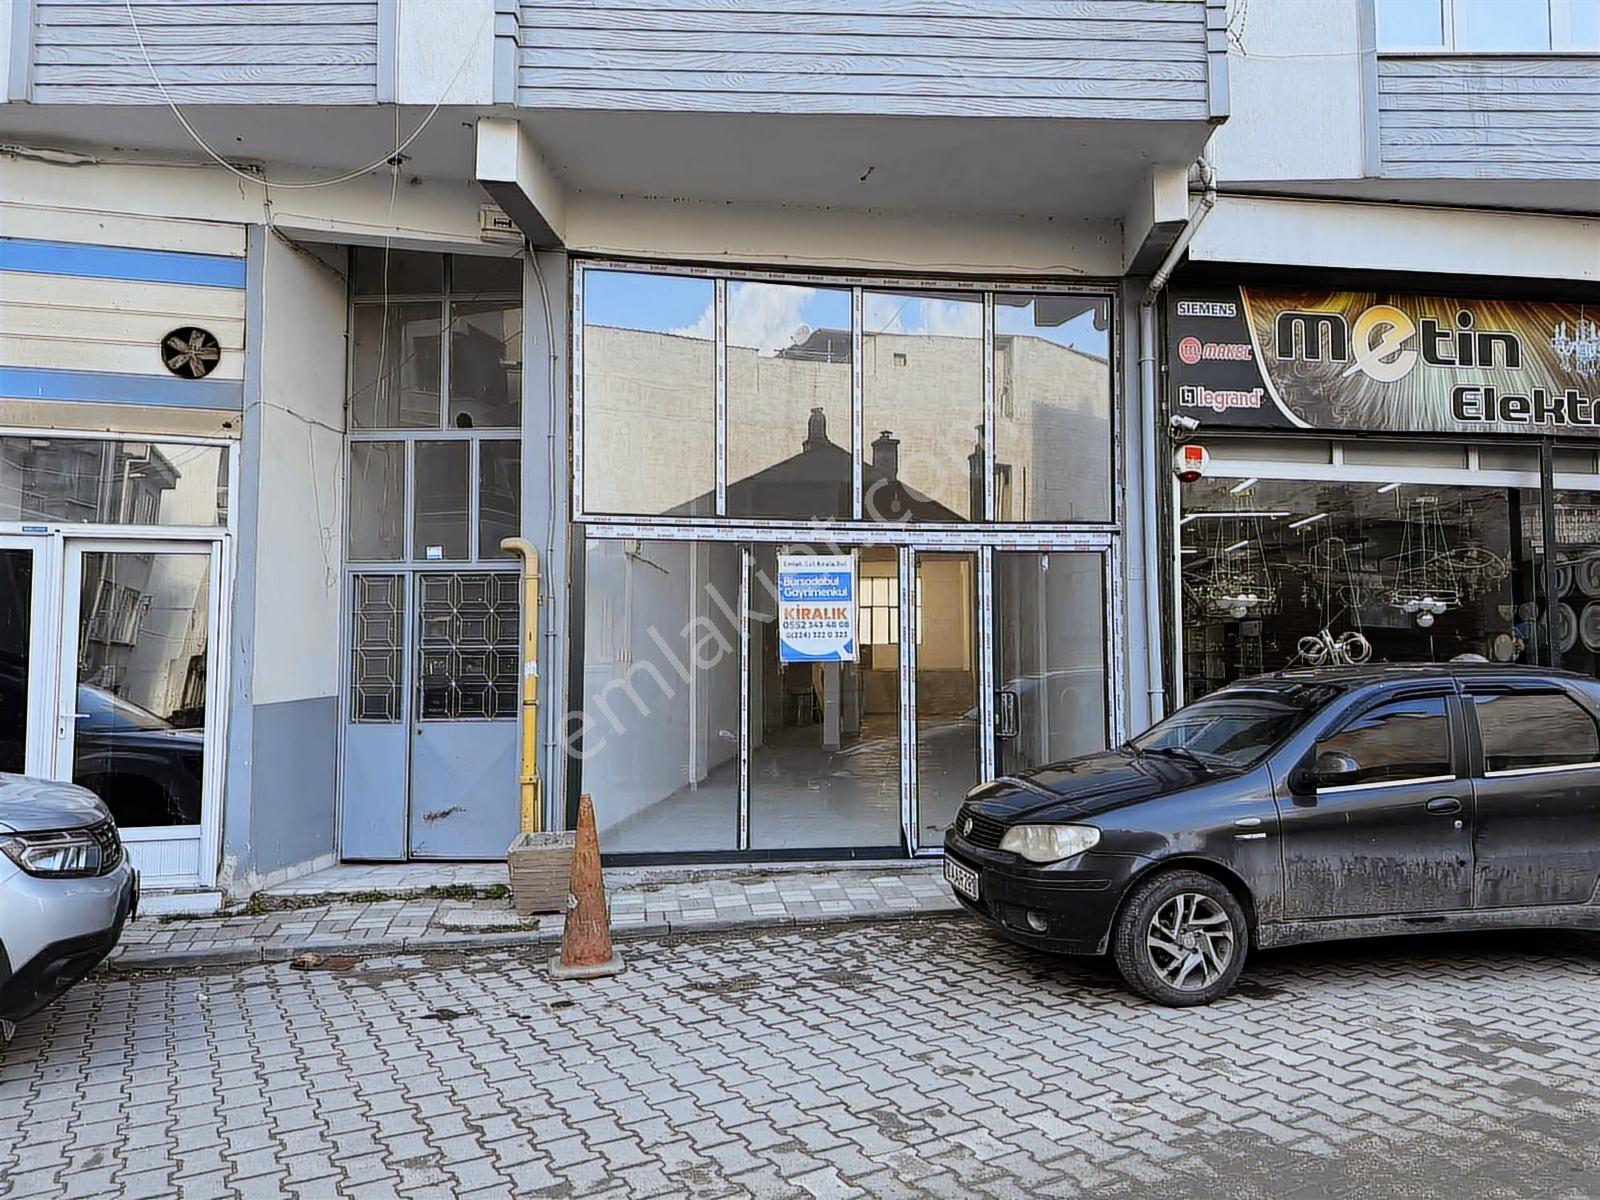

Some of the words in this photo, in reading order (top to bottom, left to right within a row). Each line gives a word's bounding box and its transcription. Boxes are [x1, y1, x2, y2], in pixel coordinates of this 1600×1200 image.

[1178, 302, 1236, 317] SIEMENS
[1198, 386, 1261, 412] legrand
[784, 604, 848, 619] KİRALIK
